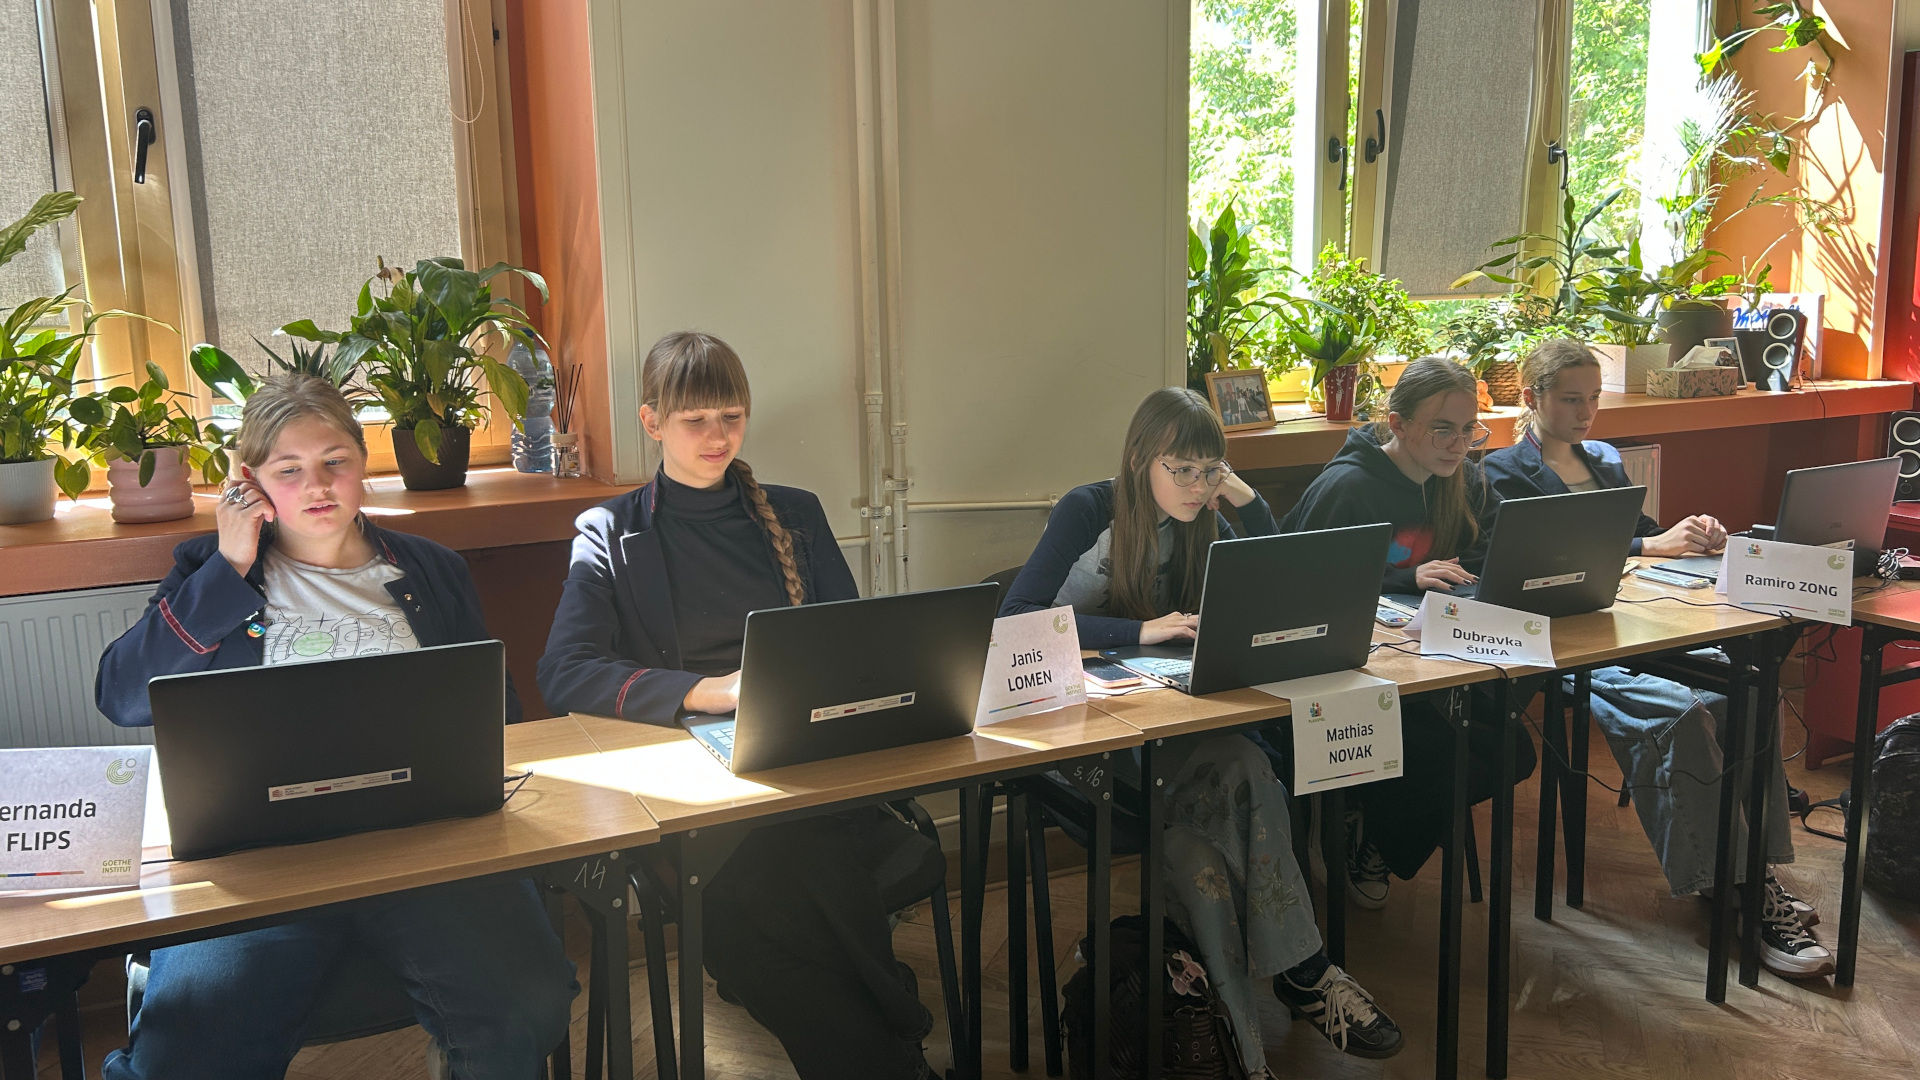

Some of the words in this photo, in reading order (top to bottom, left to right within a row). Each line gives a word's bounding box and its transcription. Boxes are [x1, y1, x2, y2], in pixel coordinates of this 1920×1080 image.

[1745, 574, 1795, 590] Ramiro
[1799, 581, 1838, 597] ZONG
[1453, 628, 1523, 648] Dubravka
[1011, 648, 1043, 668] Janis
[1007, 669, 1053, 692] LOMEN
[1326, 723, 1374, 743] Mathias
[1329, 744, 1373, 765] NOVAK
[0, 798, 97, 821] ernanda
[6, 830, 71, 851] FLIPS
[102, 859, 132, 867] GOETHE
[102, 866, 131, 874] INSTITUT
[574, 858, 606, 890] 14
